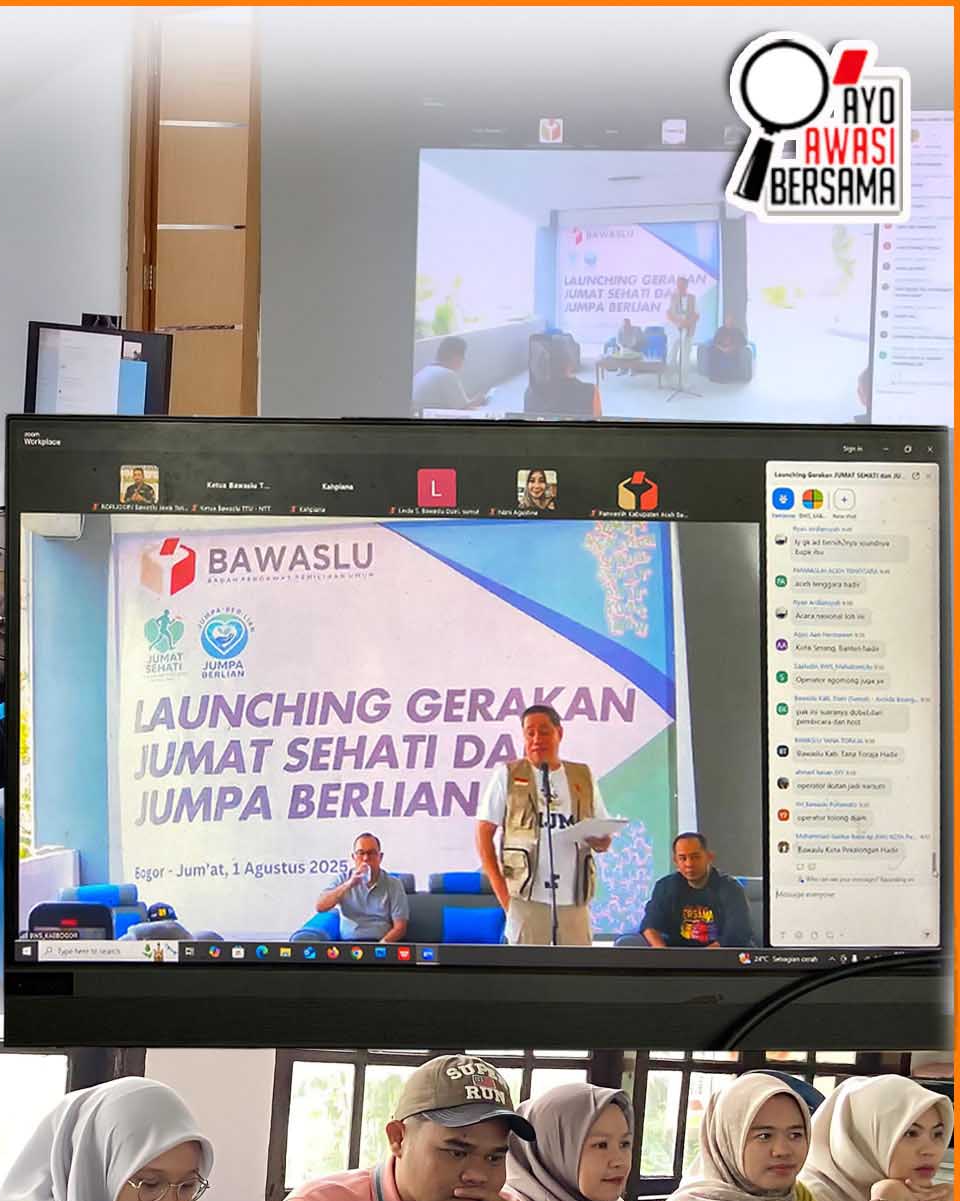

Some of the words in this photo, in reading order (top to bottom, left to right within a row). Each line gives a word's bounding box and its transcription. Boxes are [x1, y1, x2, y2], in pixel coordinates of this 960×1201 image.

[641, 273, 706, 285] GERAAN
[24, 438, 61, 446] Workplace
[431, 479, 442, 497] L
[209, 542, 374, 574] BAWASLU
[146, 652, 183, 663] JUMAT
[202, 660, 244, 671] JUMPA
[145, 663, 182, 674] SEHATI
[201, 670, 245, 679] BERLIAN
[134, 687, 391, 734] LAUNCHING
[134, 738, 274, 781] JUMAT
[283, 734, 438, 773] SEHATI
[453, 733, 526, 770] DA
[134, 783, 273, 827] JUMPA
[287, 780, 480, 820] BERLIAN
[135, 866, 165, 881] Bogor
[176, 863, 230, 879] Jum'at,
[233, 861, 240, 876] 1
[244, 861, 306, 877] Agustus
[310, 859, 349, 875] 2025
[464, 1086, 506, 1105] RUN
